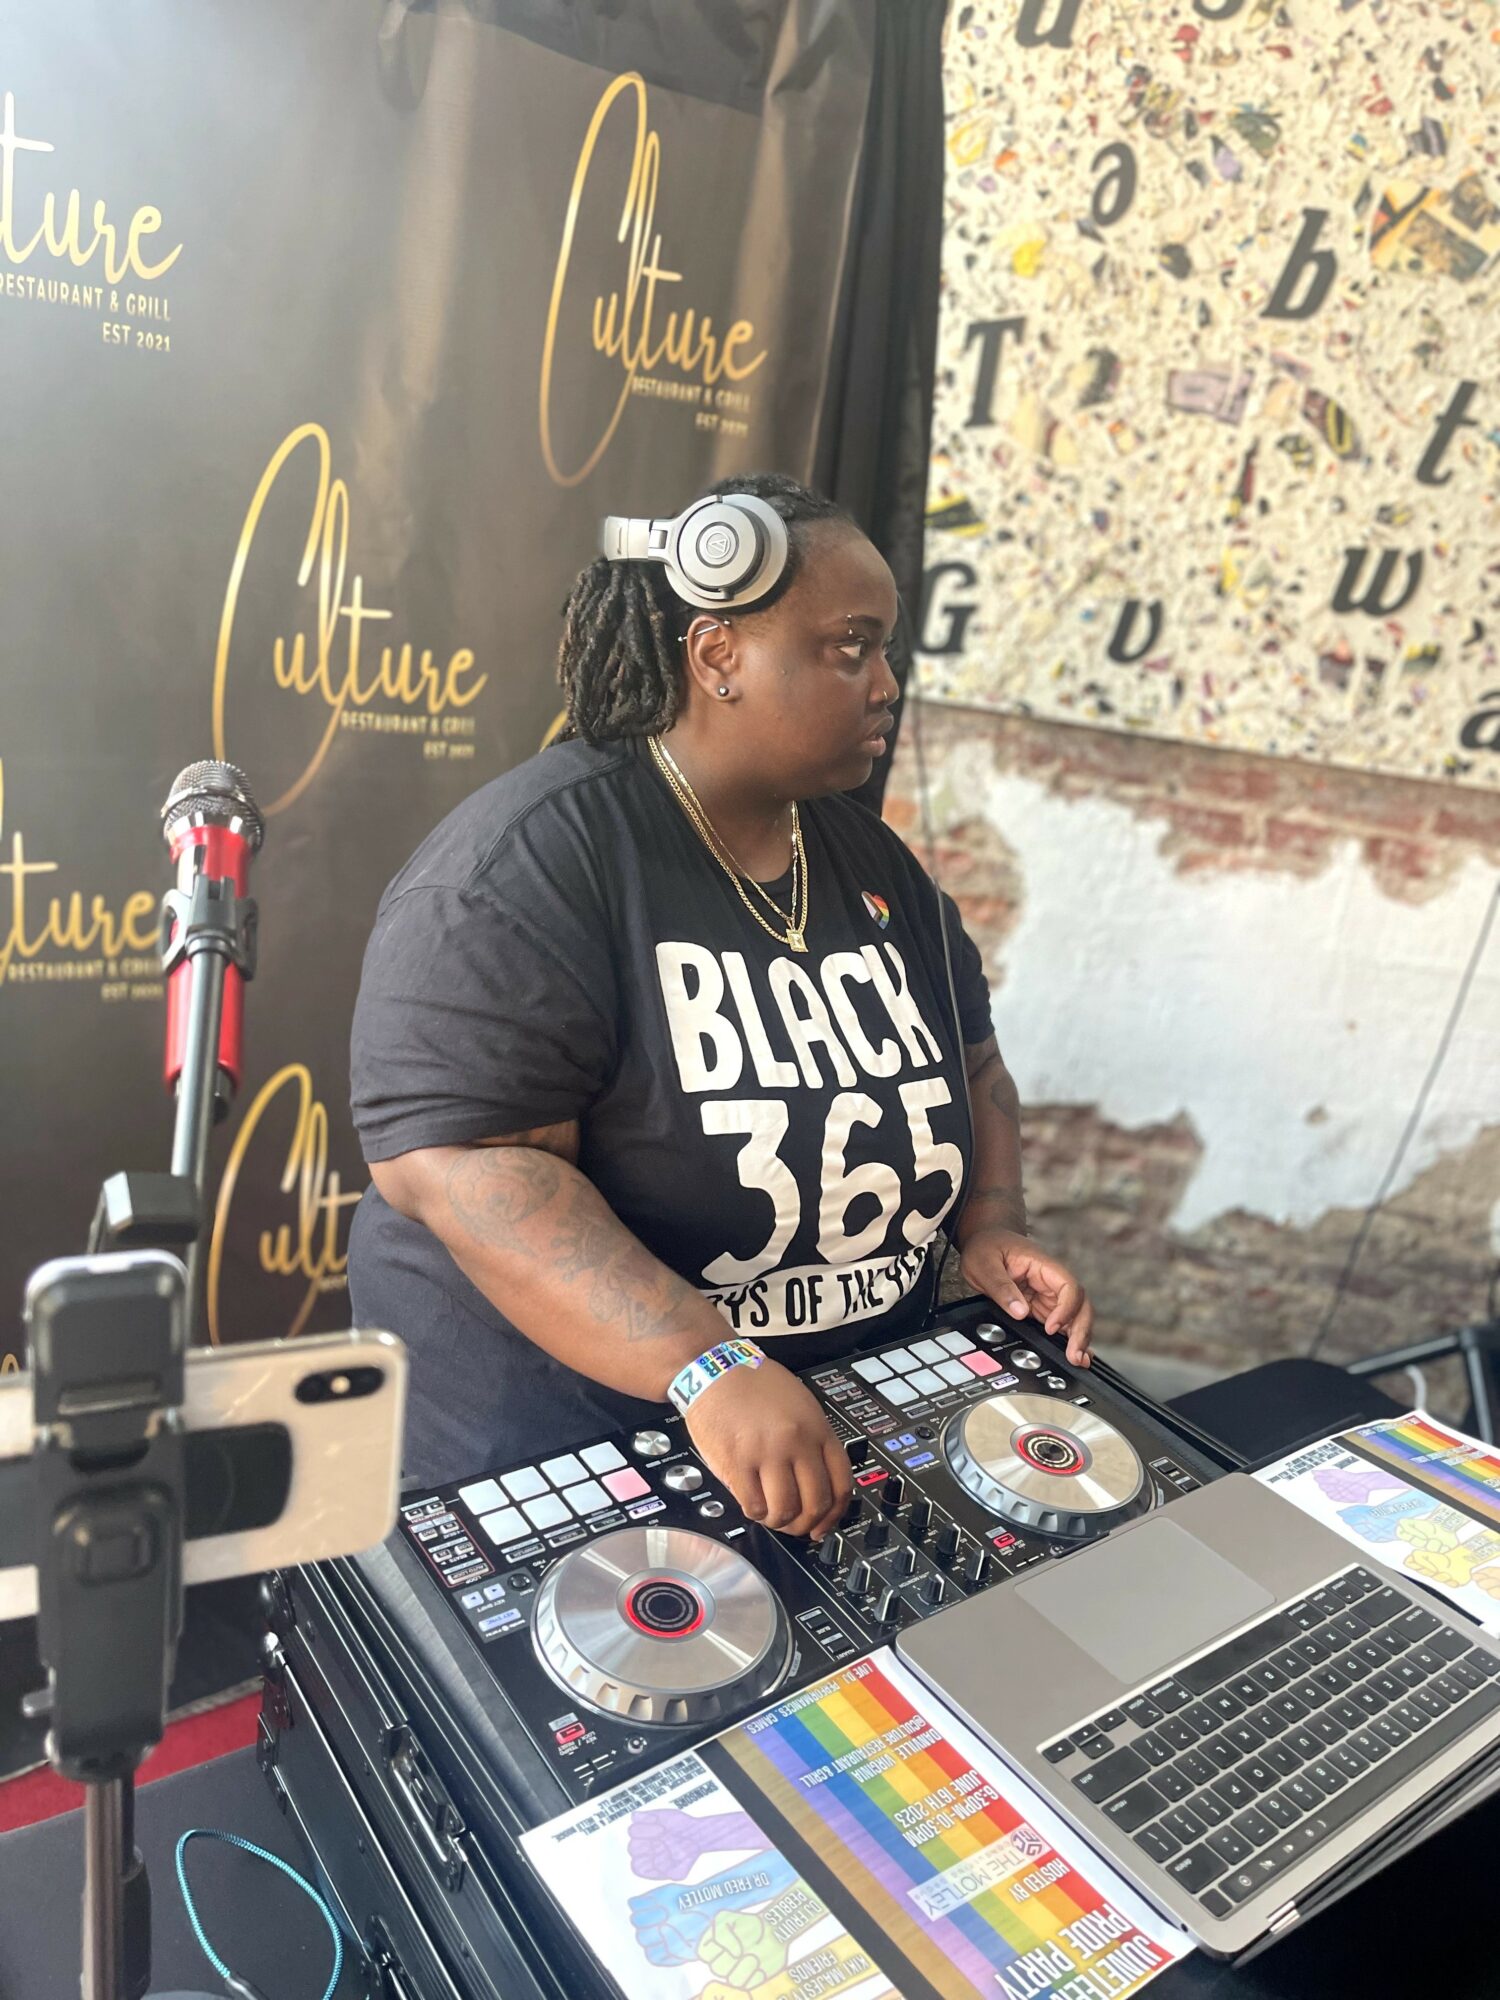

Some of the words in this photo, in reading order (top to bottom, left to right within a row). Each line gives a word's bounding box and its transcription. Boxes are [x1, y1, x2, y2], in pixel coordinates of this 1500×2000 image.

[0, 91, 183, 284] ture
[539, 71, 768, 487] Culture
[1261, 207, 1338, 320] b
[110, 289, 119, 312] &
[126, 293, 171, 322] GRILL
[103, 322, 131, 346] EST
[136, 331, 171, 352] 2021
[962, 317, 1025, 430] T
[1415, 380, 1480, 487] t
[212, 423, 488, 816] Culture
[0, 830, 162, 957] ture
[655, 941, 943, 1093] BLACK
[700, 1077, 964, 1286] 365
[207, 1062, 362, 1348] Cult
[706, 1279, 768, 1328] YS
[785, 1275, 823, 1327] OF
[836, 1267, 884, 1319] THE
[704, 1345, 753, 1378] OVER
[674, 1370, 702, 1406] 21
[852, 1662, 874, 1680] LIVE
[882, 1714, 927, 1741] @CULTURE
[831, 1738, 885, 1773] RESTAURANT
[850, 1753, 896, 1784] VIRGINIA
[799, 1764, 835, 1788] &GRILL
[949, 1769, 982, 1795] JUNE
[893, 1802, 930, 1828] 2023
[924, 1786, 955, 1810] 16TH
[753, 1871, 770, 1888] DR
[987, 1849, 1025, 1876] THE
[1022, 1857, 1070, 1893] HOSTED
[677, 1884, 723, 1911] MOTLEY
[723, 1876, 752, 1895] FRED
[923, 1867, 992, 1916] MOTLEY
[1008, 1882, 1029, 1903] BY
[764, 1888, 807, 1926] PEBBLES
[804, 1900, 822, 1915] DJ
[772, 1912, 806, 1943] FRUITY
[1057, 1903, 1134, 1960] PRIDE
[787, 1950, 838, 1984] FRIENDS
[844, 1953, 869, 1976] KIKI
[994, 1940, 1076, 2000] PARTY
[1048, 1935, 1162, 2000] JUNETEE
